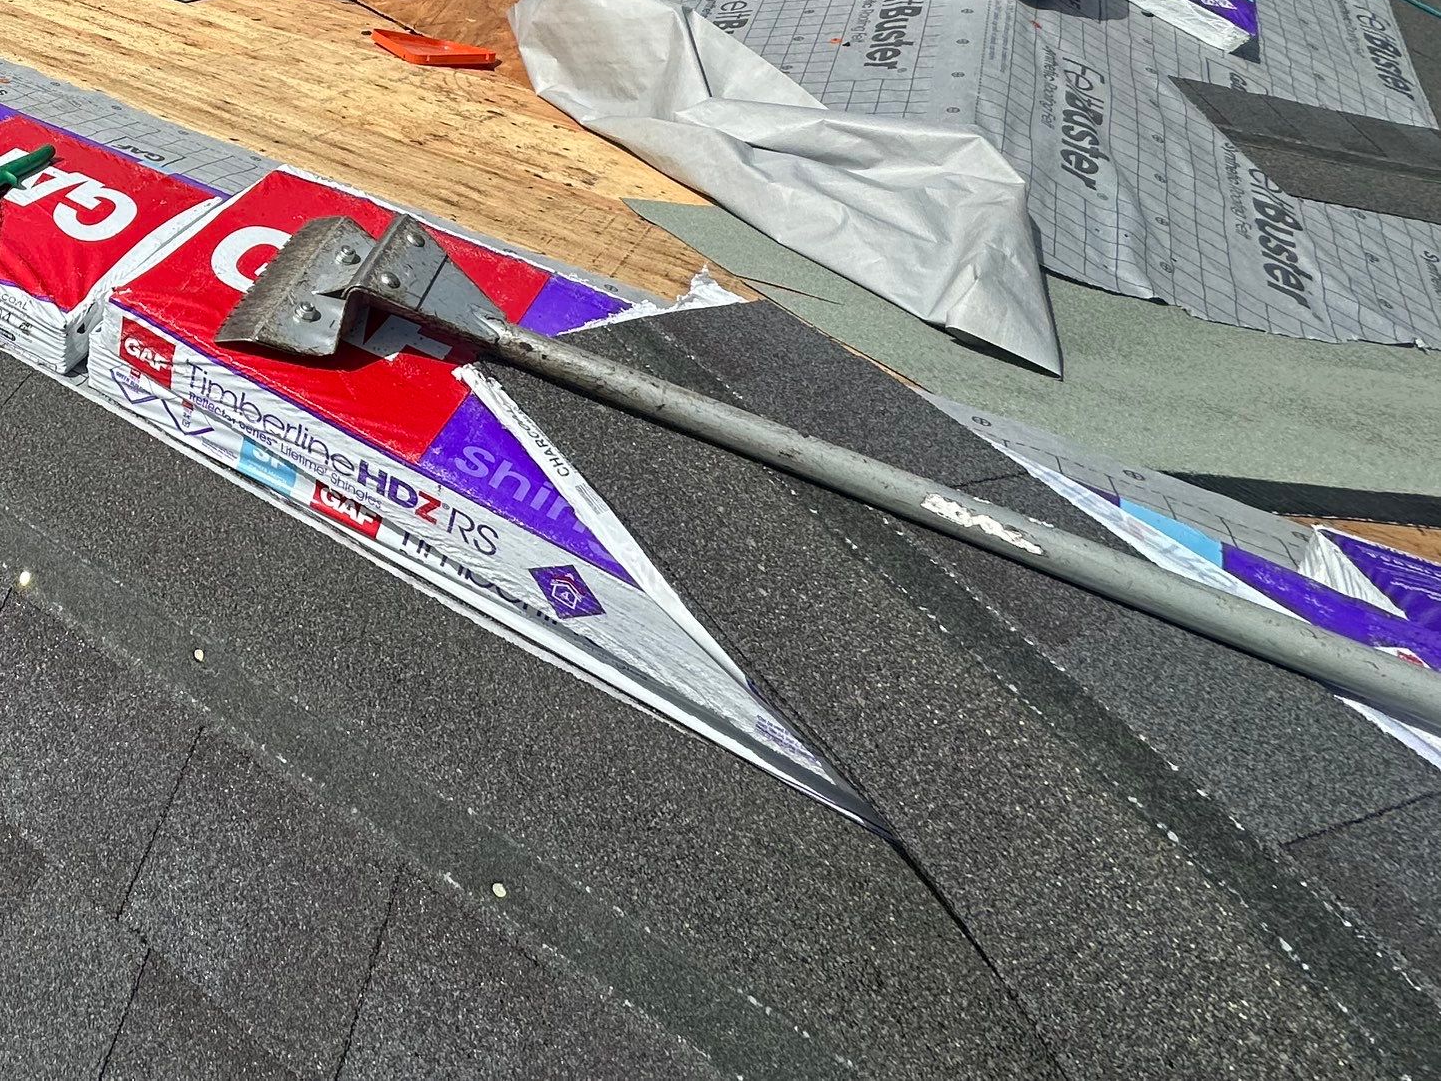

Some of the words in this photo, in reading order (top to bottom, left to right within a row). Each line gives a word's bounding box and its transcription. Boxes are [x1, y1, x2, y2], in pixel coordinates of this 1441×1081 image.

[1060, 57, 1109, 190] FeltBuster
[112, 136, 166, 163] GAF
[1249, 168, 1313, 310] eltBuster
[124, 337, 172, 372] GAF
[186, 359, 443, 525] TimberlineHDZ
[448, 508, 499, 557] RS
[321, 489, 381, 533] GAF
[330, 471, 382, 510] Shingles
